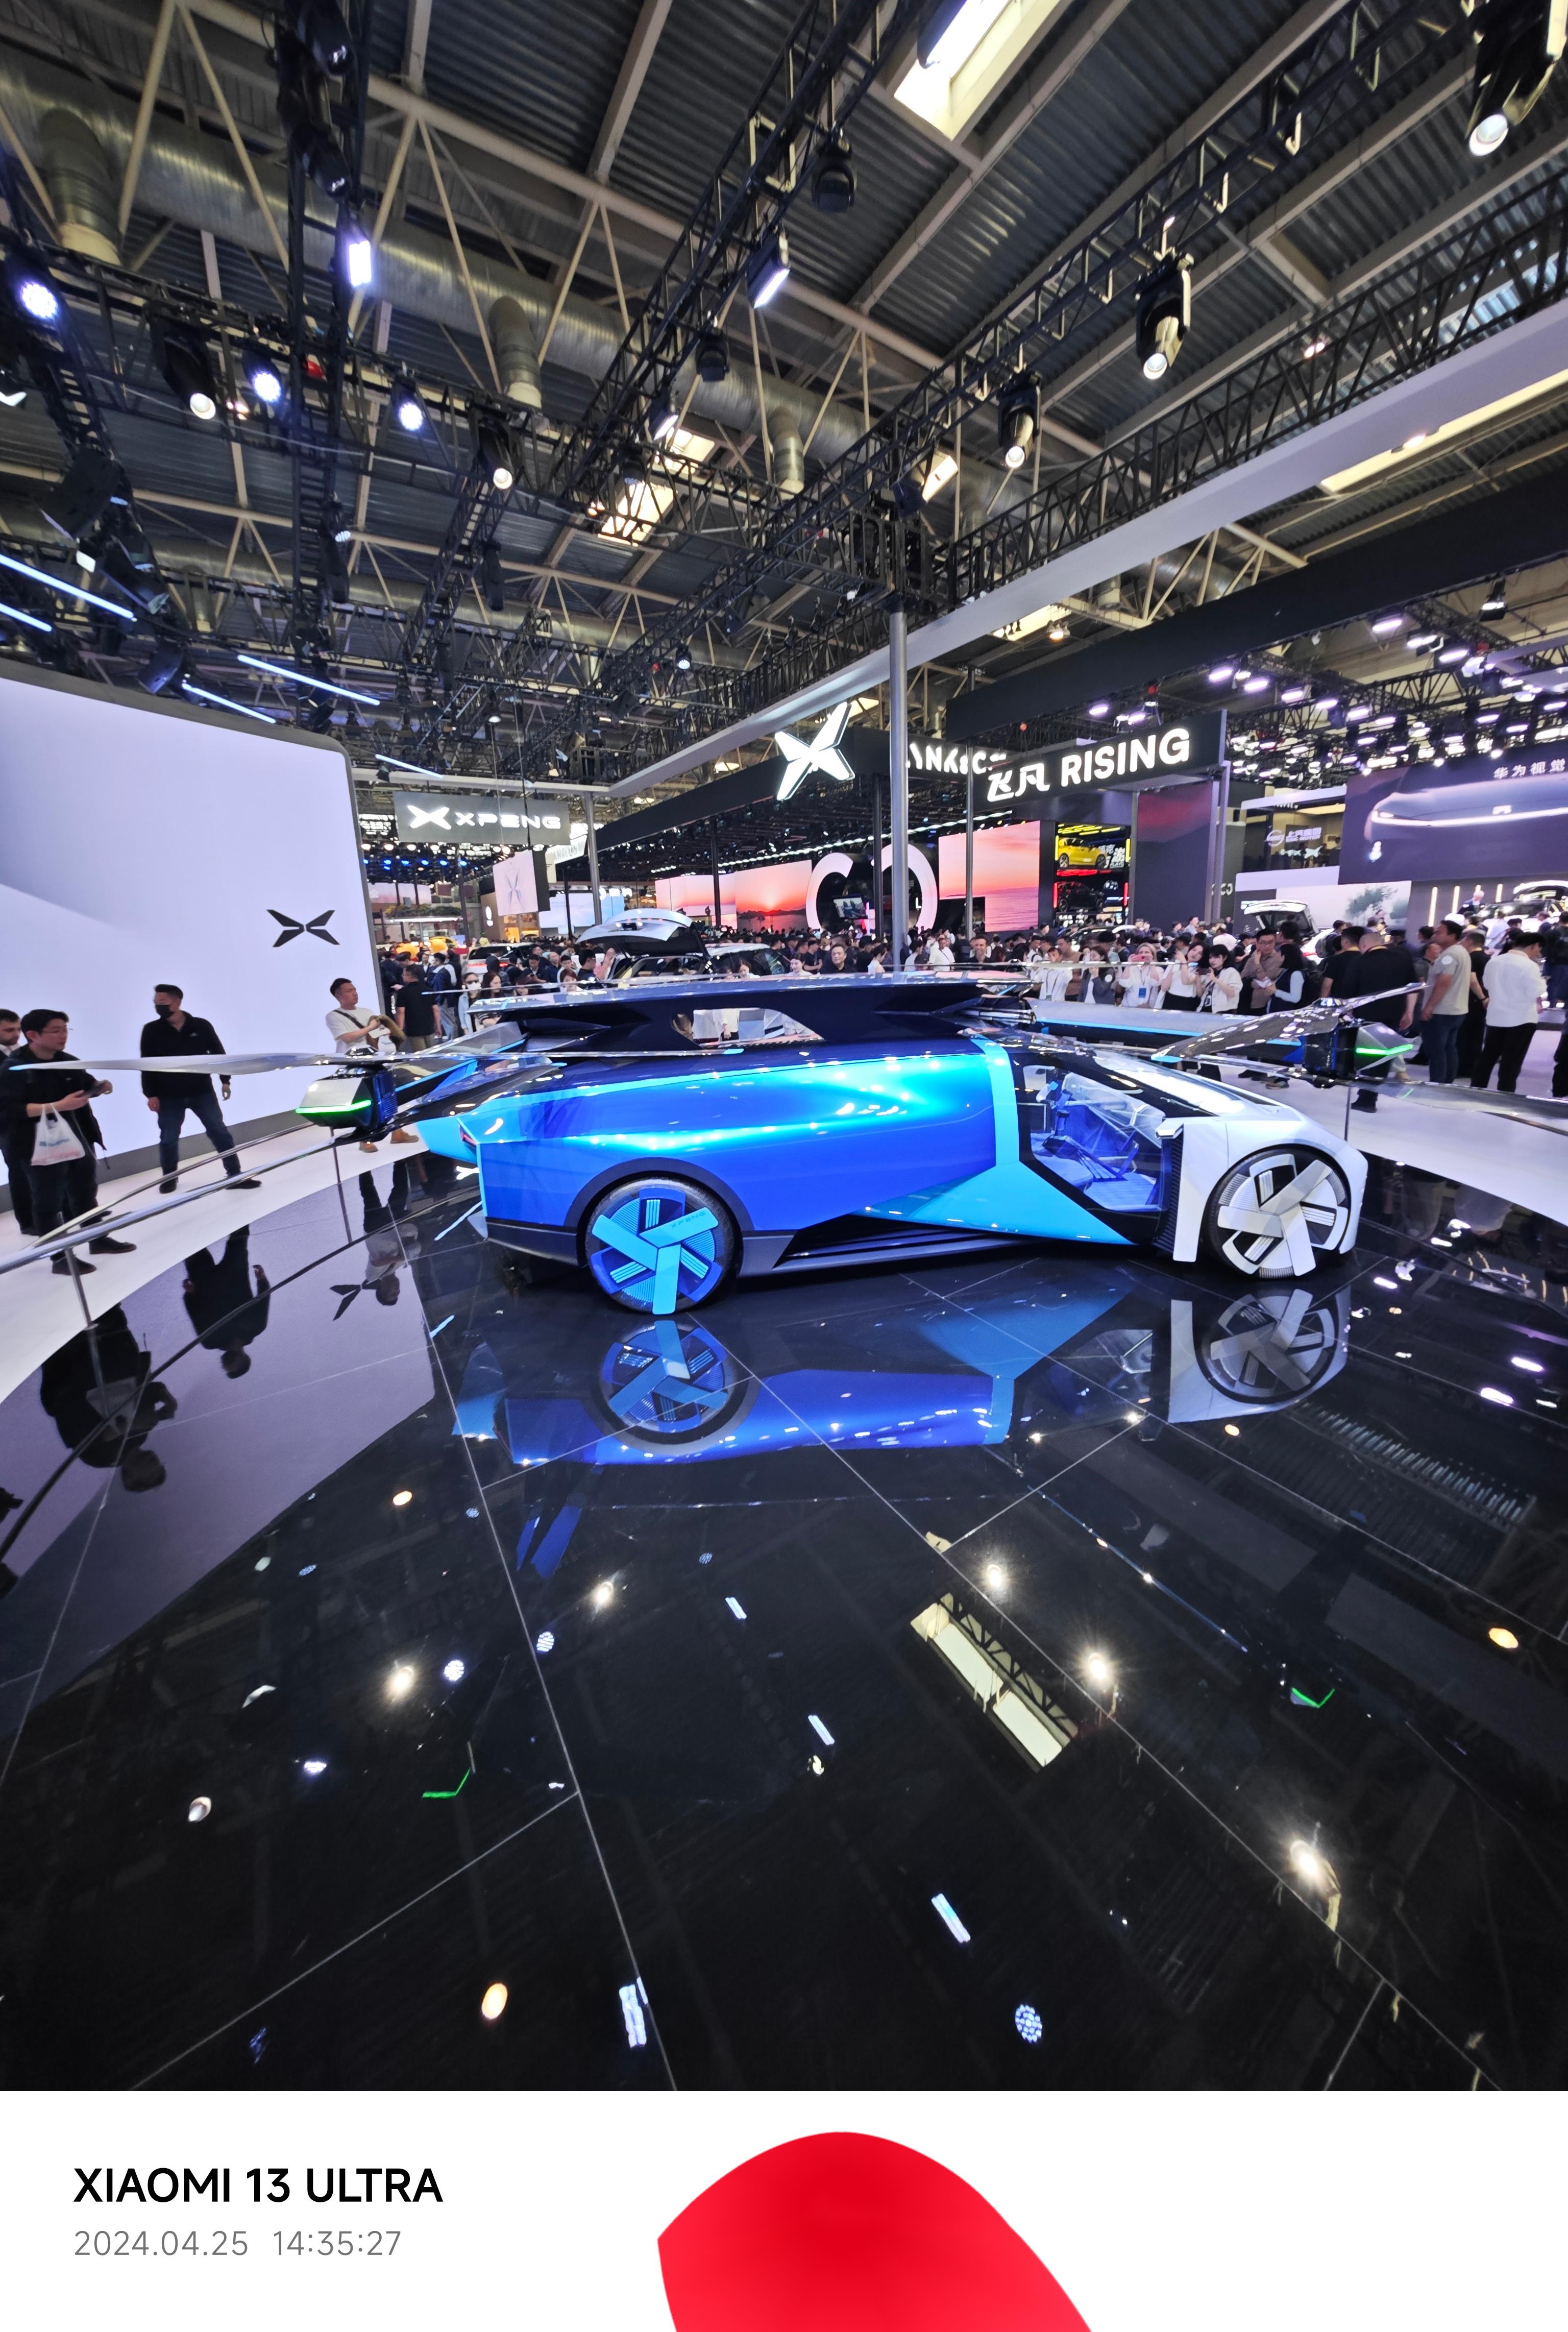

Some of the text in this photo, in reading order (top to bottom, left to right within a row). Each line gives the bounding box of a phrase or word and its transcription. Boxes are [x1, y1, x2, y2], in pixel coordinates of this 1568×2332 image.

[987, 727, 1190, 803] 飞凡 RISING
[455, 812, 561, 830] XPENG
[671, 1211, 705, 1228] XPENG
